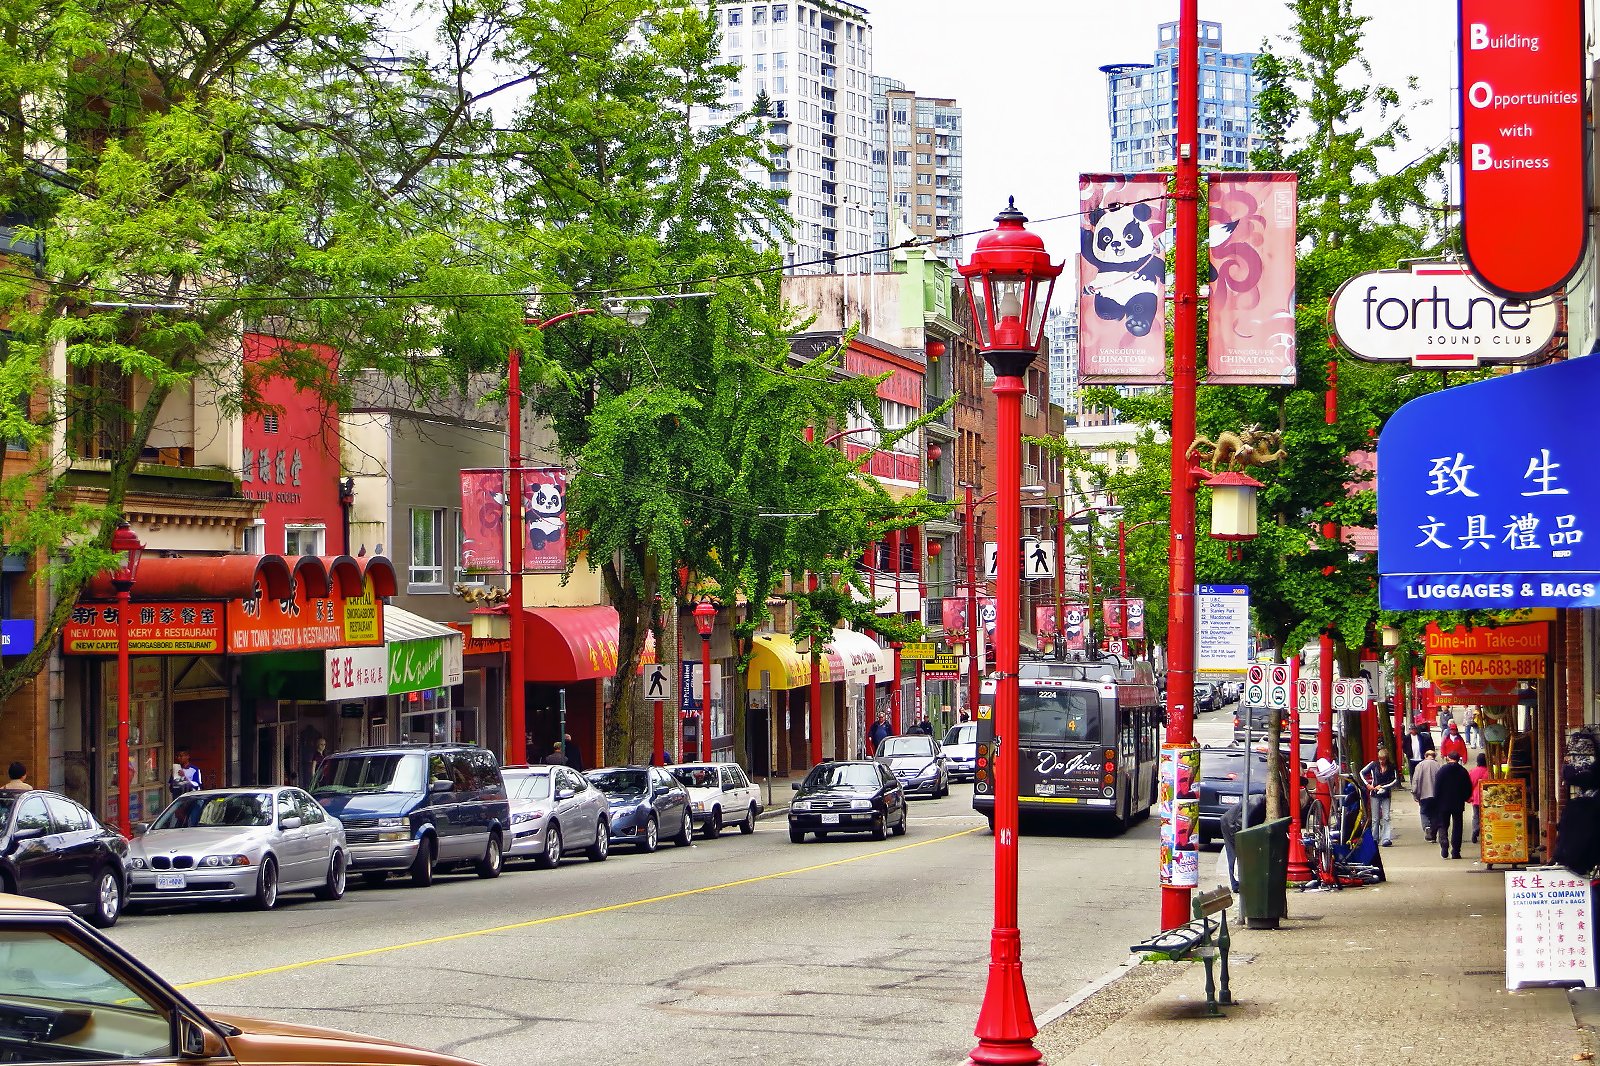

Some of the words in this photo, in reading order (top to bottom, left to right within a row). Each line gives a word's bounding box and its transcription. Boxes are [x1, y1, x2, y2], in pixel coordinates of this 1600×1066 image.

[1470, 23, 1540, 52] Building
[1468, 81, 1578, 110] Opportunities
[1499, 123, 1533, 137] with
[1471, 143, 1549, 171] Business
[1362, 285, 1531, 331] fortune
[1427, 335, 1482, 344] SOUND
[1492, 335, 1532, 344] CLUB
[1091, 355, 1155, 363] CHINATOWN
[1220, 356, 1284, 364] CHINATOWN
[1425, 448, 1569, 497] 致生
[276, 492, 302, 504] SOCIETY
[1414, 512, 1584, 550] 文具禮品
[1406, 583, 1514, 599] LUGGAGES
[1520, 583, 1534, 597] &
[1540, 582, 1595, 597] BAGS
[346, 608, 375, 619] SMORGASBORD
[70, 628, 90, 638] NEW
[92, 628, 116, 638] TOWN
[128, 628, 152, 637] KERY
[155, 628, 161, 637] &
[164, 628, 218, 637] RESTAURANT
[349, 620, 372, 632] RESTAURANT
[234, 630, 249, 648] NEW
[250, 630, 270, 648] TOWN
[272, 628, 295, 646] BAKERY
[302, 626, 341, 644] RESTAURANT
[1430, 633, 1476, 648] Dine-in
[1484, 632, 1541, 648] Take-out
[1433, 660, 1456, 676] Tel:
[1461, 659, 1545, 676] 604-683-8816
[1068, 720, 1076, 731] 4
[1064, 752, 1100, 774] Vinci
[1512, 874, 1545, 888] 致生
